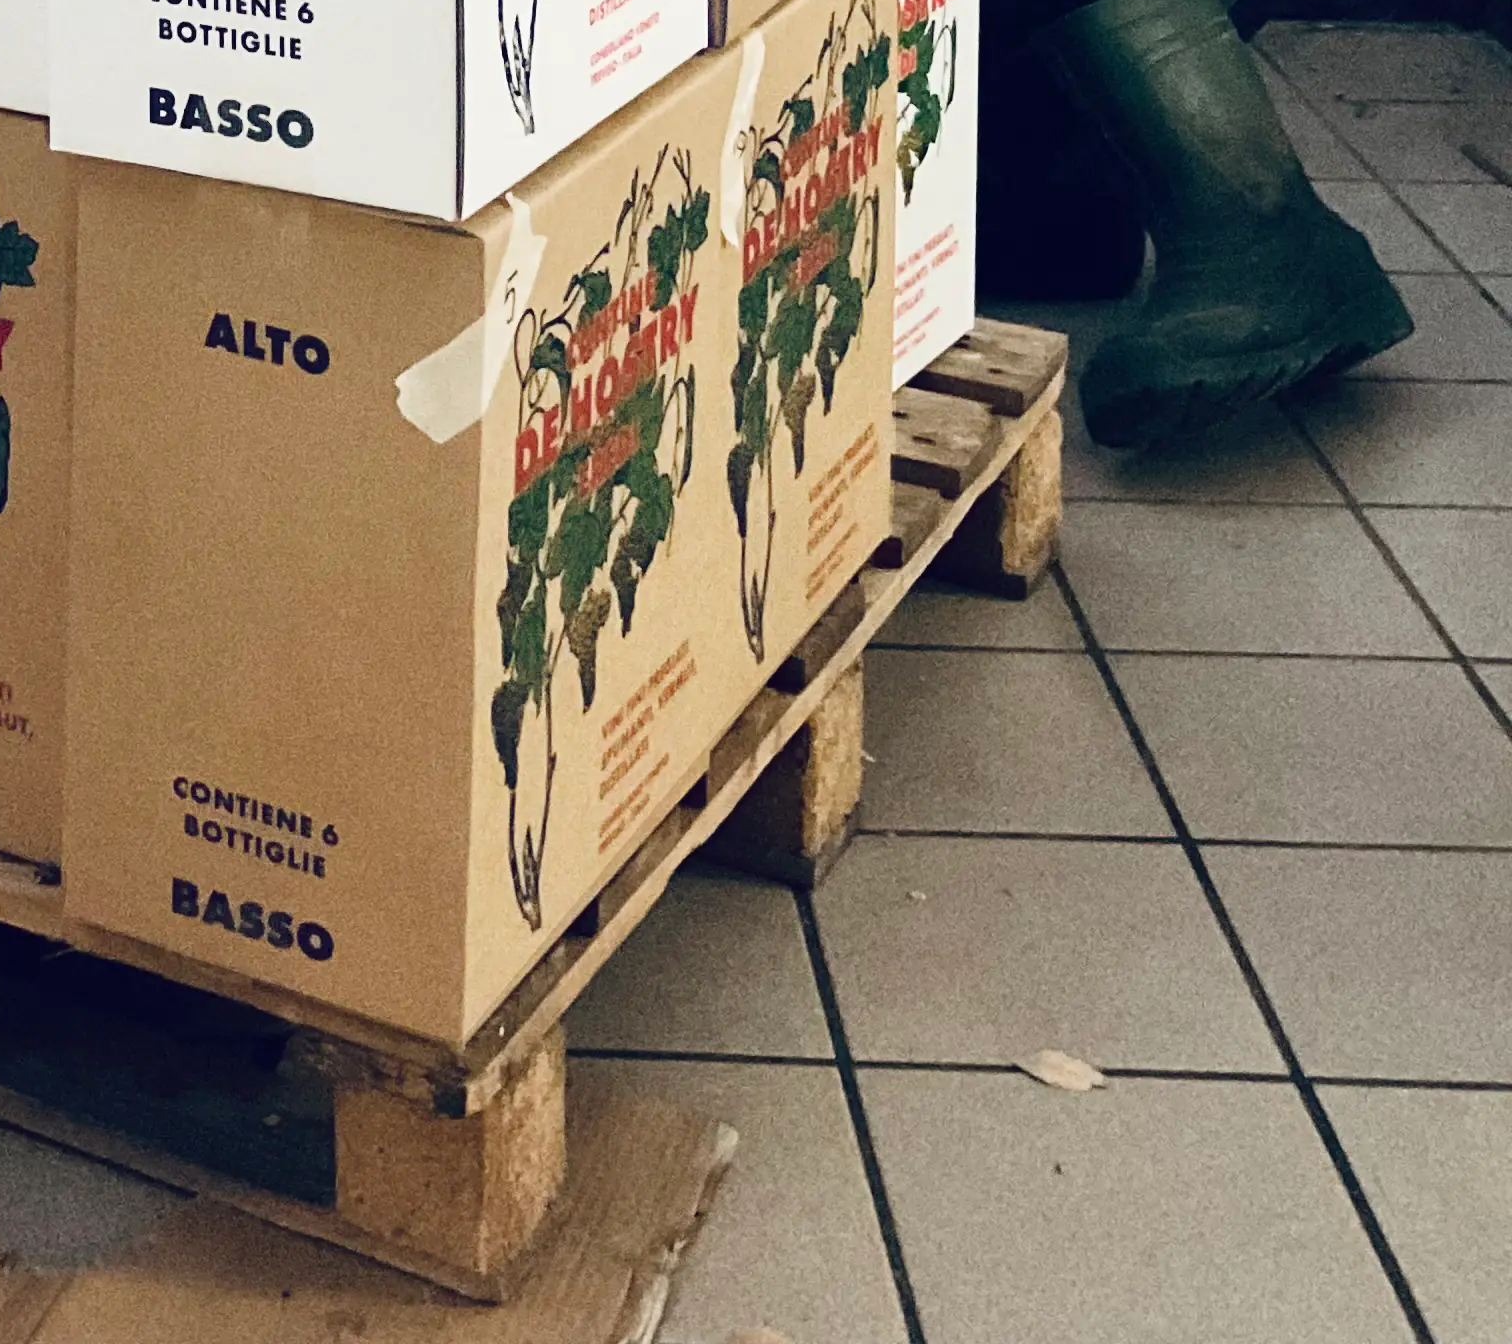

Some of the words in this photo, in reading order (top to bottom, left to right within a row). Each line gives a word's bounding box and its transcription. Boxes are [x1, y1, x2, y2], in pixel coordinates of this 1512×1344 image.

[158, 17, 302, 61] BOTTIGLIE
[297, 1, 315, 24] 6
[148, 86, 315, 149] BASSO
[743, 208, 777, 284] DE
[203, 311, 331, 375] ALTO
[514, 403, 560, 498] DE
[570, 282, 699, 434] HOSTRY
[173, 776, 313, 839] CONTIENE
[322, 824, 339, 846] 6
[184, 813, 326, 879] BOTTIGLIE
[172, 877, 335, 961] BASSO
